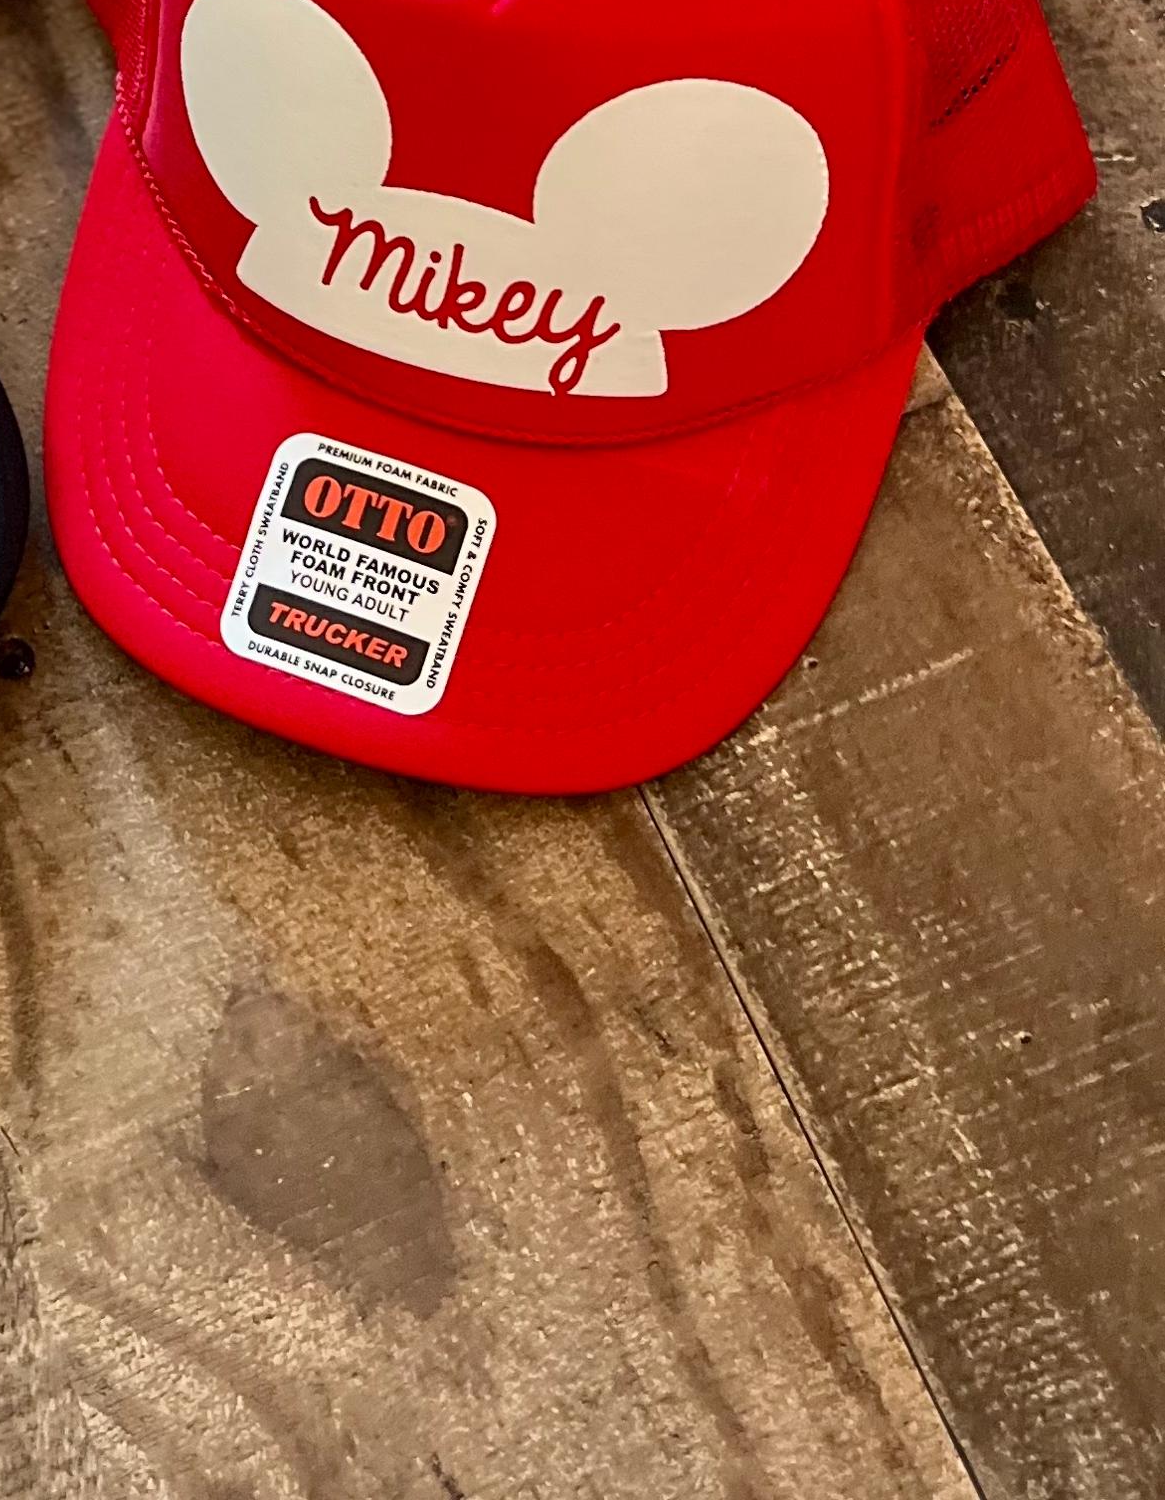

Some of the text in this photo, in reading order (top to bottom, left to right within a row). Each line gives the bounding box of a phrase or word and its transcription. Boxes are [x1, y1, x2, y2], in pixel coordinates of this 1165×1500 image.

[308, 196, 621, 398] Mikey
[317, 442, 459, 498] PREMIUM FOAM FABRIC
[231, 462, 289, 617] TERRY CLOTH SWEATBAND
[304, 475, 446, 554] OTTO
[475, 517, 488, 548] SOFT
[282, 528, 440, 595] WORLD FAMOUS
[290, 552, 421, 606] FOAM FRONT
[452, 564, 473, 610] COMFY
[290, 570, 409, 622] YOUNG ADULT
[268, 601, 408, 669] TRUCKER
[426, 612, 458, 689] SWEATBAND
[248, 640, 396, 701] DURABLE SNAP CLOSURE
